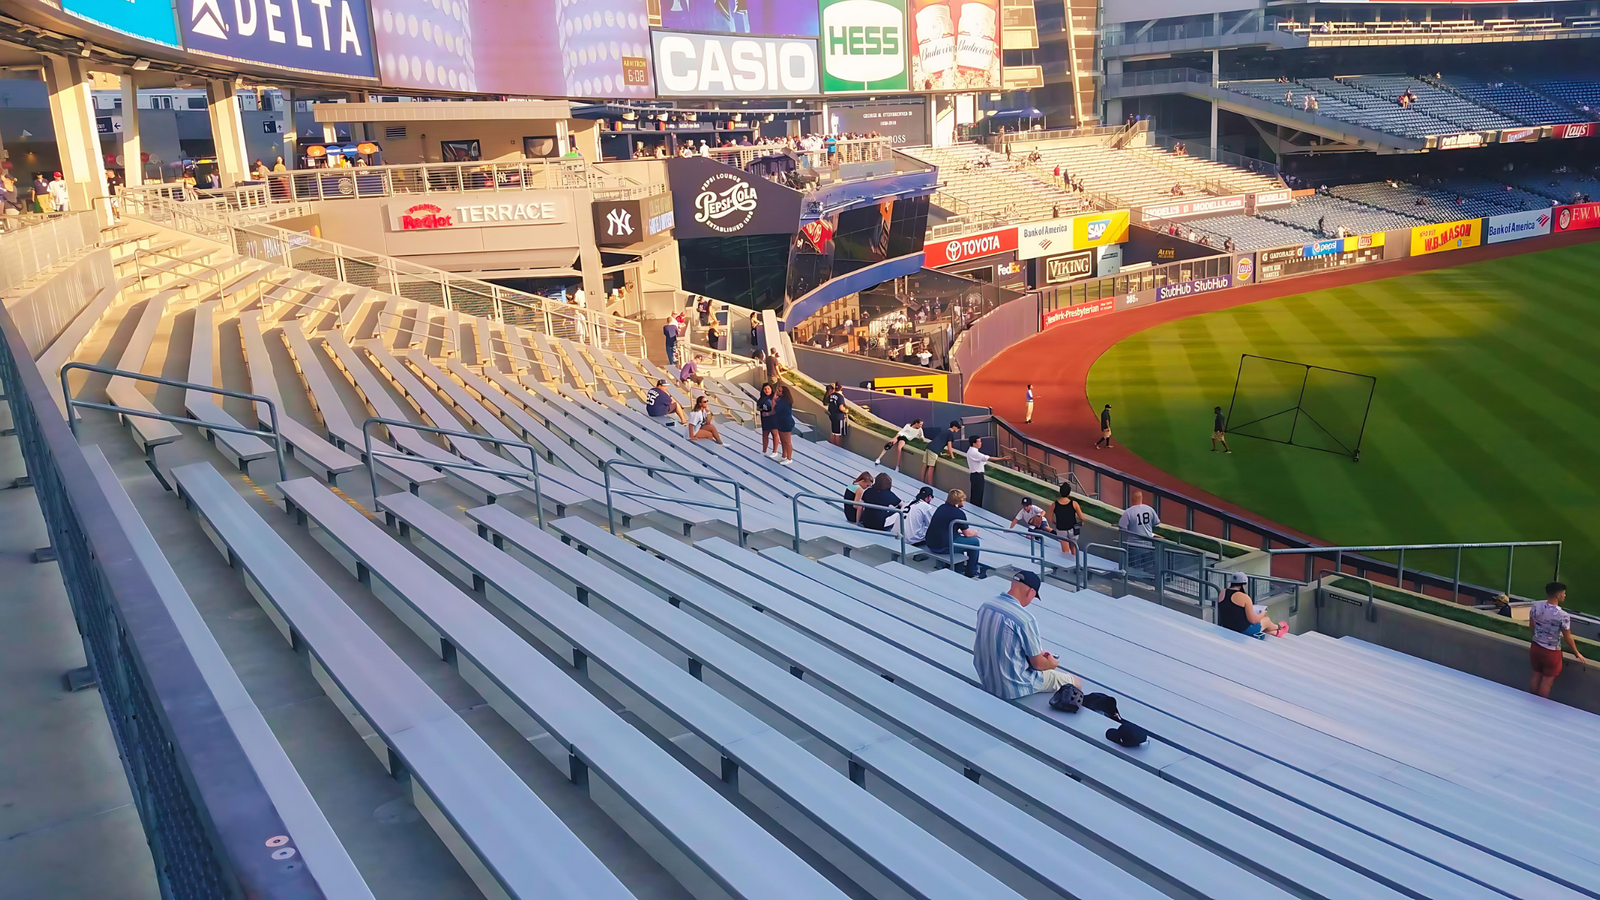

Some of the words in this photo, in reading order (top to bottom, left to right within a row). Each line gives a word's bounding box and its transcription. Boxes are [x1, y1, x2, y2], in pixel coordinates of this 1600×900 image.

[237, 0, 362, 56] DELTA
[829, 26, 899, 55] HESS
[660, 36, 815, 91] CASIO
[628, 69, 645, 82] 6:08
[701, 176, 715, 191] PEPSI
[716, 173, 741, 183] LOUNGE
[402, 214, 453, 230] RedHot
[456, 202, 556, 223] TERRACE
[706, 220, 744, 233] ESTABLISHED
[1023, 227, 1038, 238] Bank
[1045, 223, 1067, 235] America
[1088, 222, 1107, 240] SAP
[1489, 223, 1504, 236] Bank
[1512, 220, 1535, 232] America
[962, 235, 1000, 256] TOYOTA
[1269, 250, 1295, 259] GATORADE
[1320, 240, 1337, 252] pepsi
[998, 262, 1020, 275] FedEx
[1049, 257, 1089, 278] VIKING
[1160, 284, 1191, 299] StubHub
[1194, 277, 1228, 292] StubHub
[1137, 512, 1150, 526] 18
